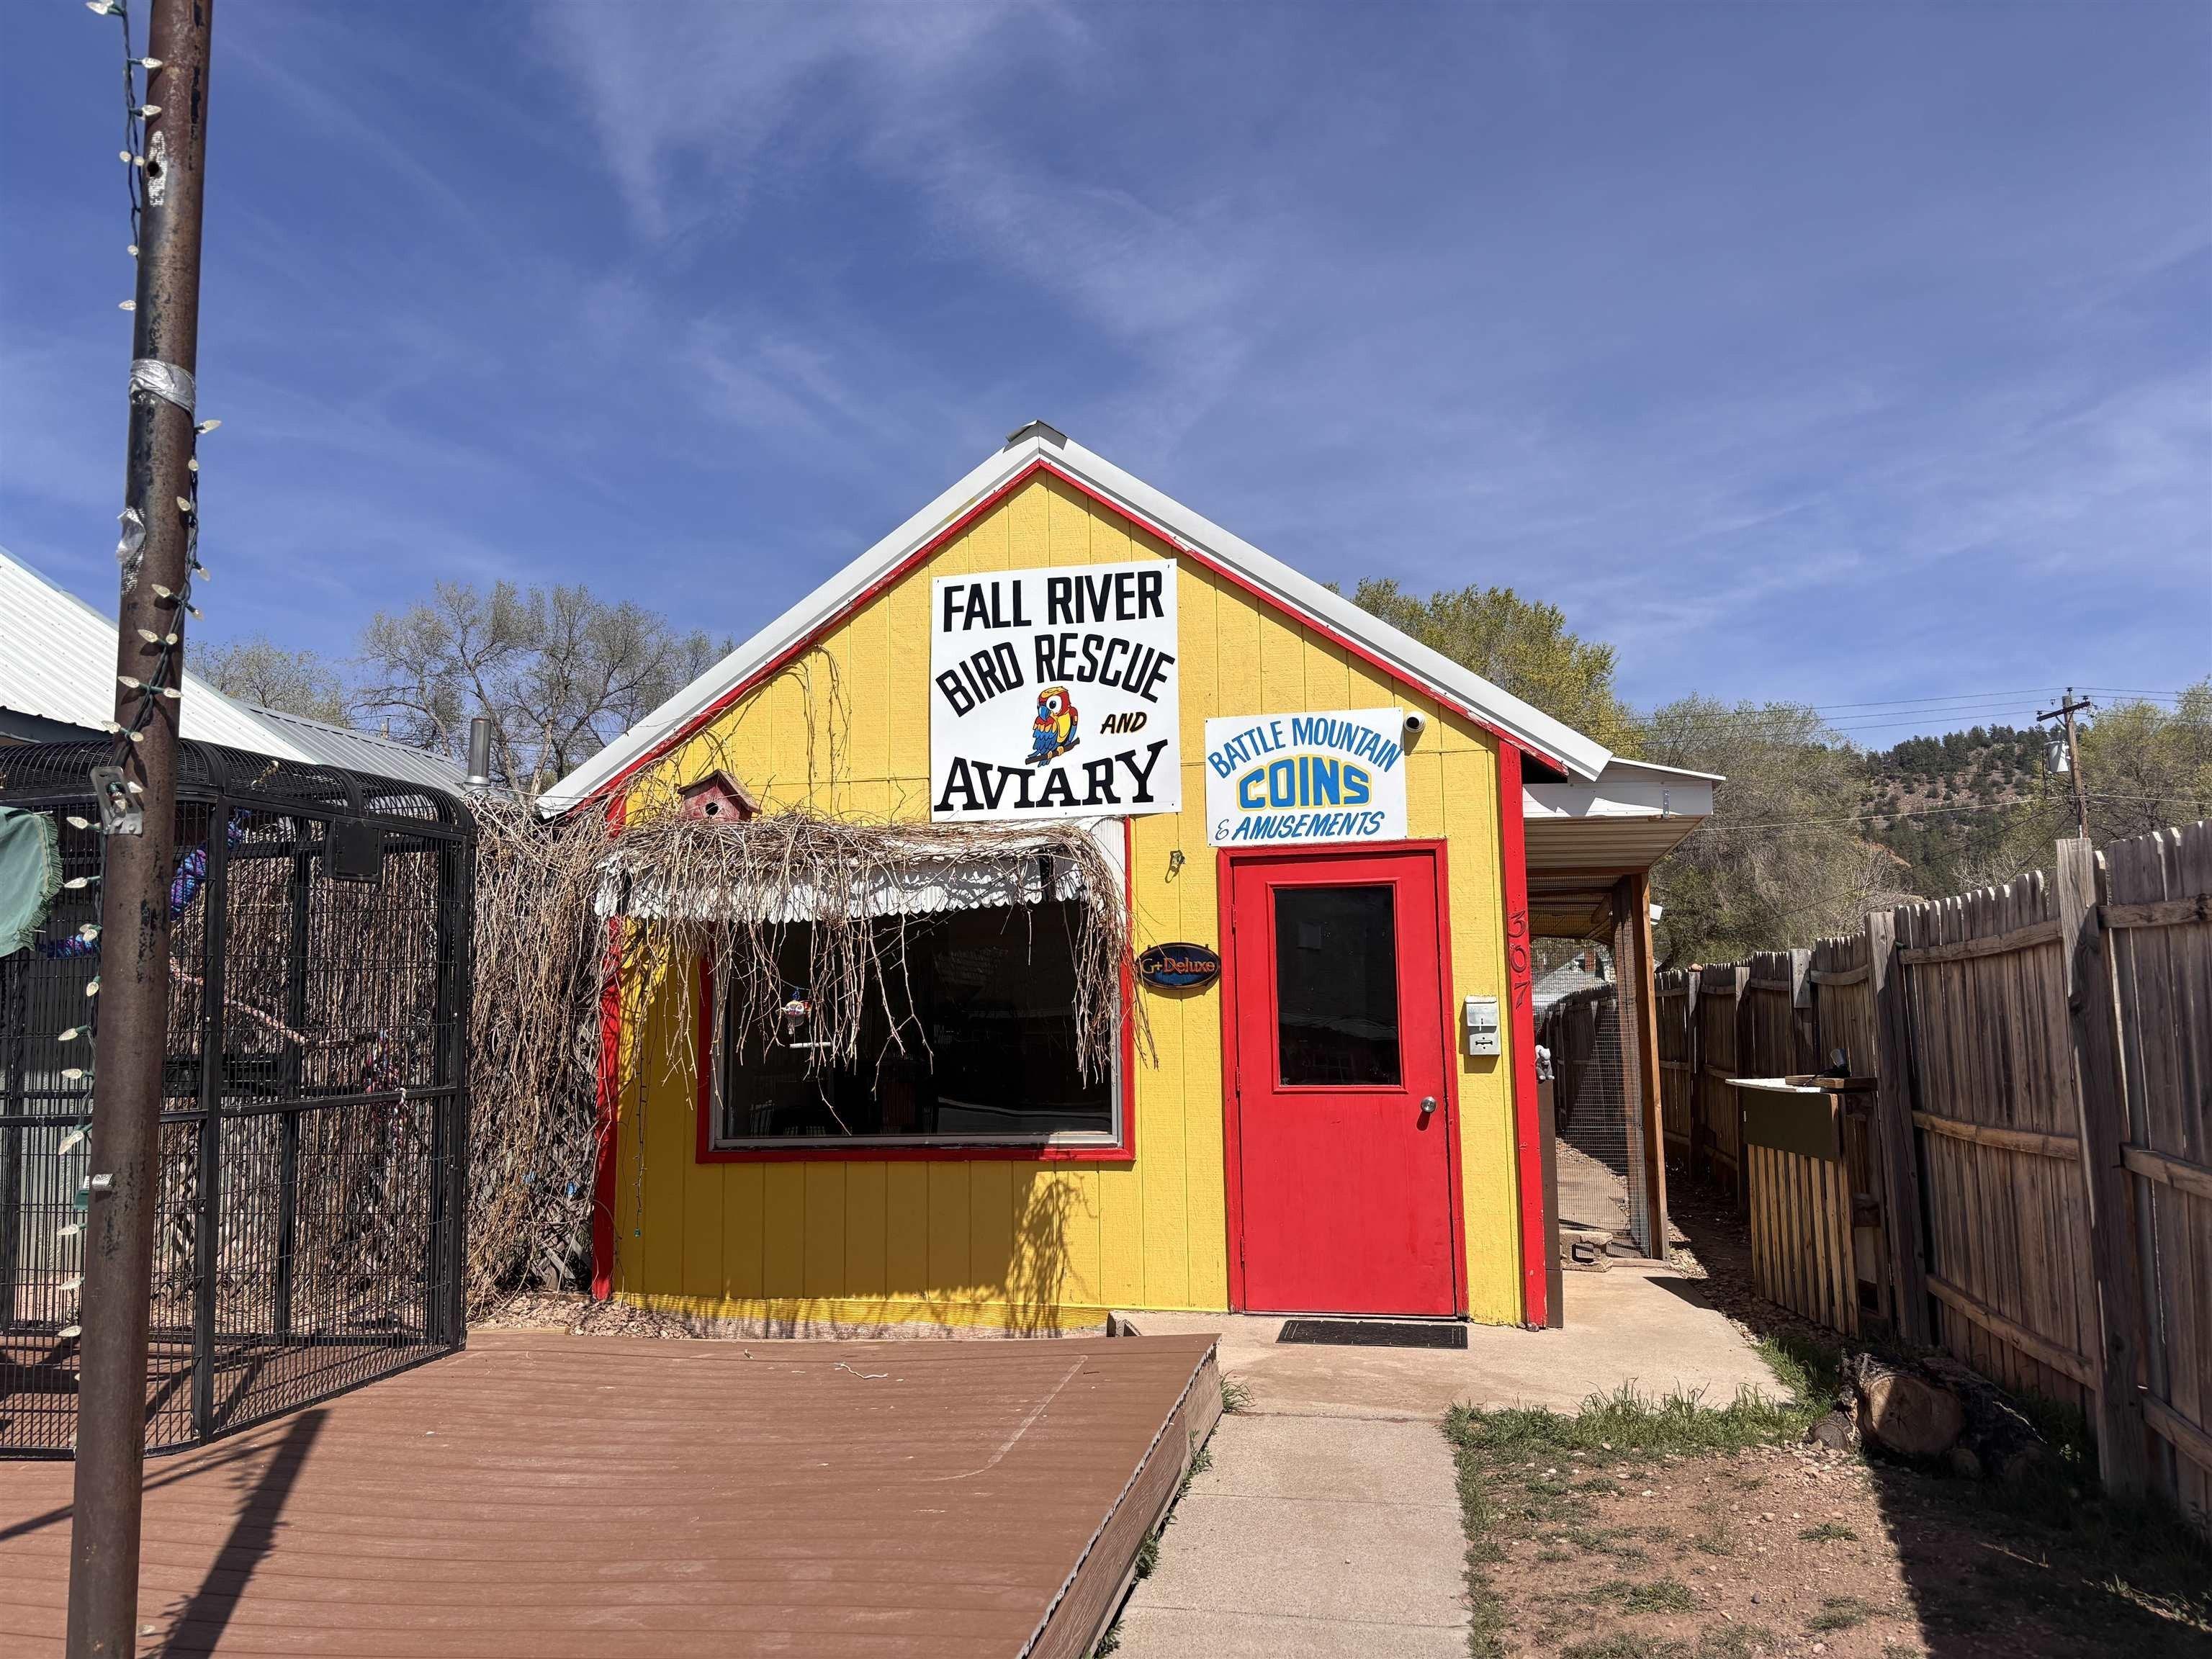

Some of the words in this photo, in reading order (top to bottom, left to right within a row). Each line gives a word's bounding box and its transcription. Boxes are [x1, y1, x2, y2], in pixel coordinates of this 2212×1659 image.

[943, 580, 1032, 632] FALL
[1047, 570, 1164, 625] RIVER
[935, 642, 1024, 717] BIRD
[1034, 633, 1176, 703] RESCUE
[1100, 711, 1147, 734] AND
[1208, 720, 1286, 778] BATTLE
[1292, 717, 1404, 773] MOUNTAIN
[934, 739, 1169, 812] AVIARY
[1236, 753, 1373, 811] COINS
[1215, 819, 1230, 841] &
[1231, 811, 1385, 841] AMUSEMENTS
[1508, 910, 1530, 1010] 307
